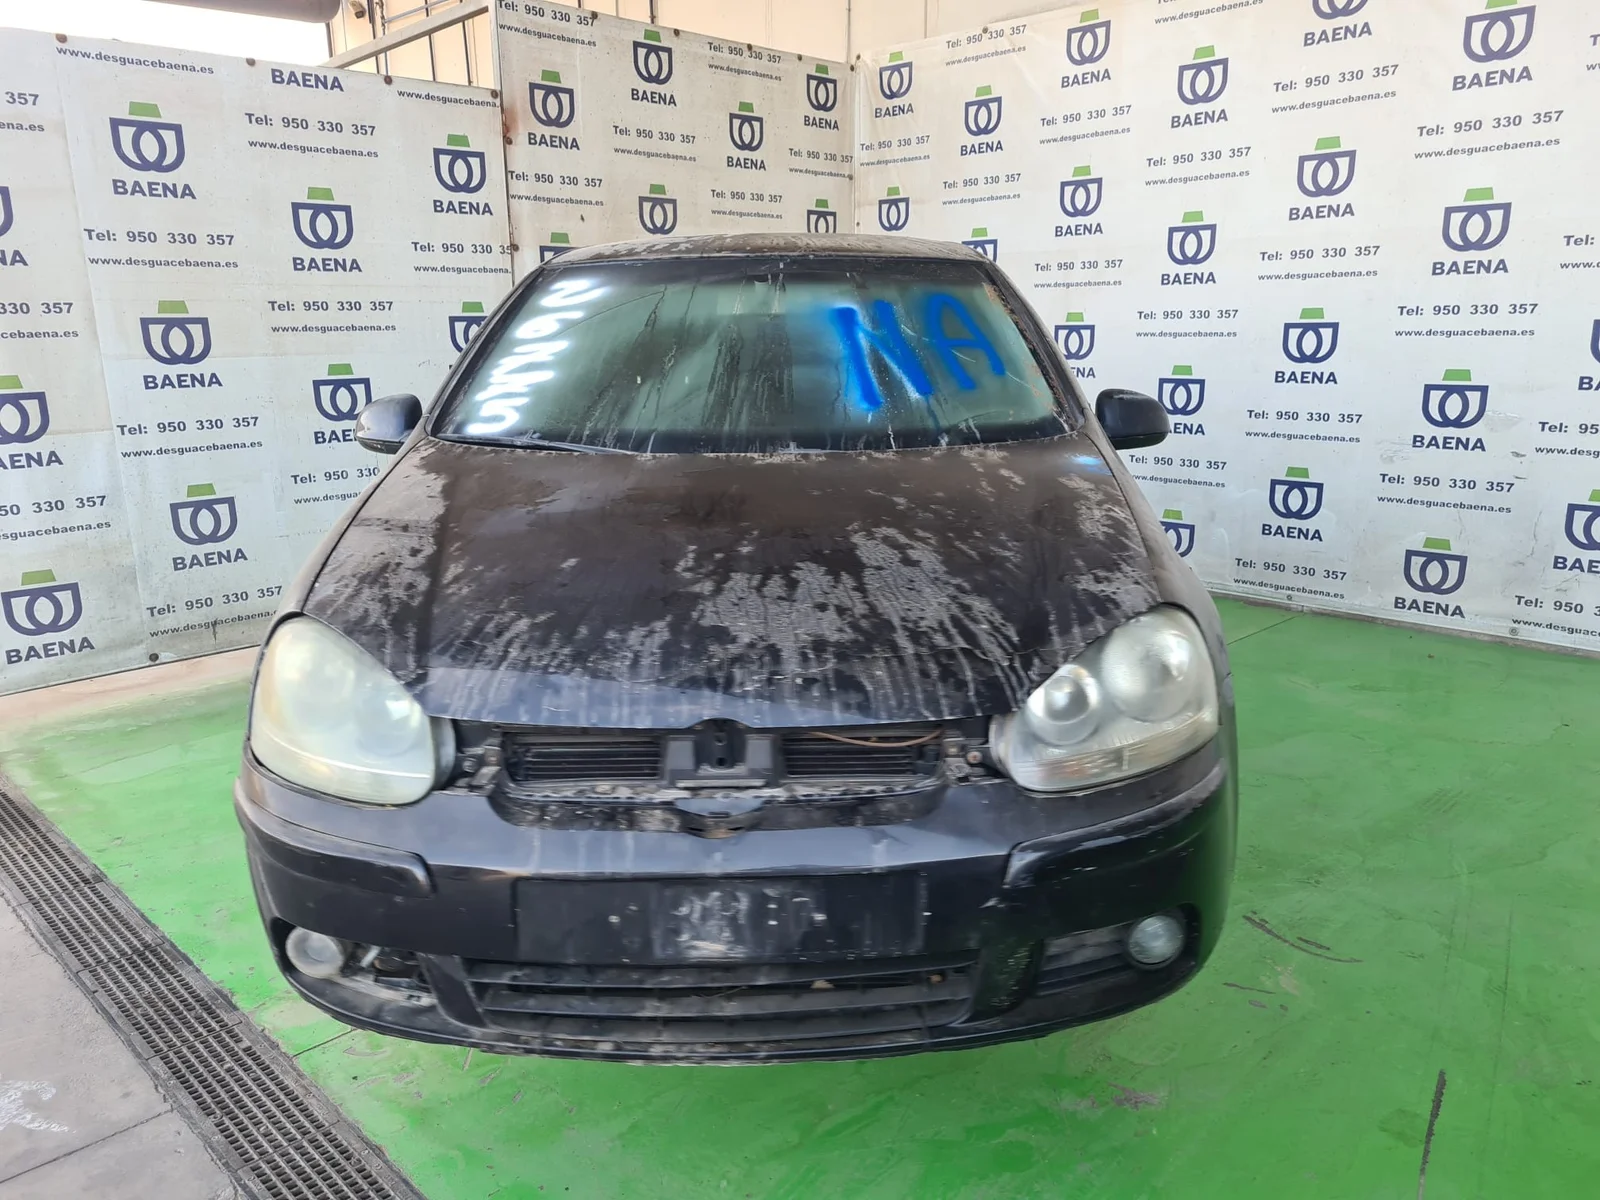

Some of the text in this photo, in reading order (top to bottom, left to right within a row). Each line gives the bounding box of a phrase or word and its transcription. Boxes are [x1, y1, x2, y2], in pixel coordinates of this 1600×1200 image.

[524, 4, 570, 22] 950 330
[499, 23, 597, 47] www.desguacebaena.es
[946, 24, 1026, 49] Tel: 950 330 357
[1303, 21, 1372, 47] BAENA
[56, 47, 214, 74] www.desguacebaena.es
[271, 68, 344, 92] BAENA
[1061, 68, 1111, 88] BAENA
[1273, 64, 1398, 92] Tel: 950 330 357
[1452, 65, 1532, 91] BAENA
[631, 88, 676, 106] BAENA
[1271, 91, 1396, 113] www.desguacebaena.es
[875, 103, 913, 118] BAENA
[1040, 104, 1131, 127] Tel: 950 330 357
[1171, 108, 1228, 128] BAENA
[245, 113, 375, 136] Tel: 950 330 357
[804, 115, 839, 131] BAENA
[1417, 110, 1564, 136] Tel: 950 330 357
[528, 132, 580, 150] BAENA
[612, 125, 695, 144] Tel: 950 330 357
[860, 135, 930, 151] Tel: 950 330 357
[1039, 127, 1130, 144] www.desguacebaena.es
[248, 140, 378, 157] www.desguacebaena.es
[788, 148, 853, 163] Tel: 950 330 357
[960, 140, 1003, 156] BAENA
[1146, 146, 1251, 167] Tel: 950 330 357
[1414, 138, 1560, 159] www.desguacebaena.es
[727, 156, 766, 171] BAENA
[508, 170, 602, 187] Tel: 950 330 357
[943, 173, 1021, 189] Tel: 950 330 357
[1145, 170, 1249, 185] www.desguacebaena.es
[112, 178, 196, 199] BAENA
[710, 189, 782, 203] Tel: 950 330 357
[433, 199, 493, 215] BAENA
[510, 193, 604, 206] www.desguacebaena.es
[1288, 203, 1354, 221] BAENA
[83, 228, 234, 245] Tel: 950 330 357
[1055, 223, 1103, 237] BAENA
[411, 241, 492, 254] Tel: 950 330
[1260, 245, 1380, 261] Tel: 950 330 357
[88, 257, 238, 268] www.desguacebaena.es
[292, 257, 362, 272] BAENA
[1034, 259, 1122, 271] Tel: 950 330 357
[1431, 258, 1508, 275] BAENA
[1161, 272, 1216, 285] BAENA
[1258, 270, 1377, 280] www.desguacebaena.es
[1034, 280, 1122, 289] www.desguacebaena.es
[267, 300, 393, 311] Tel: 950 330 357
[1137, 309, 1238, 319] Tel: 950 330 357
[1397, 303, 1538, 316] Tel: 950 330 357
[271, 324, 396, 333] www.desguacebaena.es
[1136, 330, 1236, 339] www.desguacebaena.es
[1395, 328, 1534, 338] www.desguacebaena.es
[828, 293, 1006, 411] NA
[143, 372, 222, 389] BAENA
[1274, 371, 1337, 384] BAENA
[1247, 409, 1362, 423] Tel: 950 330 357
[116, 416, 258, 435] Tel: 950 330 357
[1245, 431, 1360, 442] www.desguacebaena.es
[1412, 434, 1486, 451] BAENA
[121, 441, 262, 457] www.desguacebaena.es
[1129, 454, 1226, 470] Tel: 950 330 357
[290, 470, 348, 484] Tel: 950
[1379, 473, 1514, 492] Tel: 950 330 357
[1377, 496, 1511, 513] www.desguacebaena.es
[1261, 523, 1322, 541] BAENA
[172, 548, 248, 571] BAENA
[1235, 557, 1346, 580] Tel: 950 330 357
[1233, 578, 1344, 599] www.desguacebaena.es
[146, 585, 282, 617] Tel: 950 330 357
[1394, 596, 1465, 618] BAENA
[5, 636, 95, 664] BAENA
